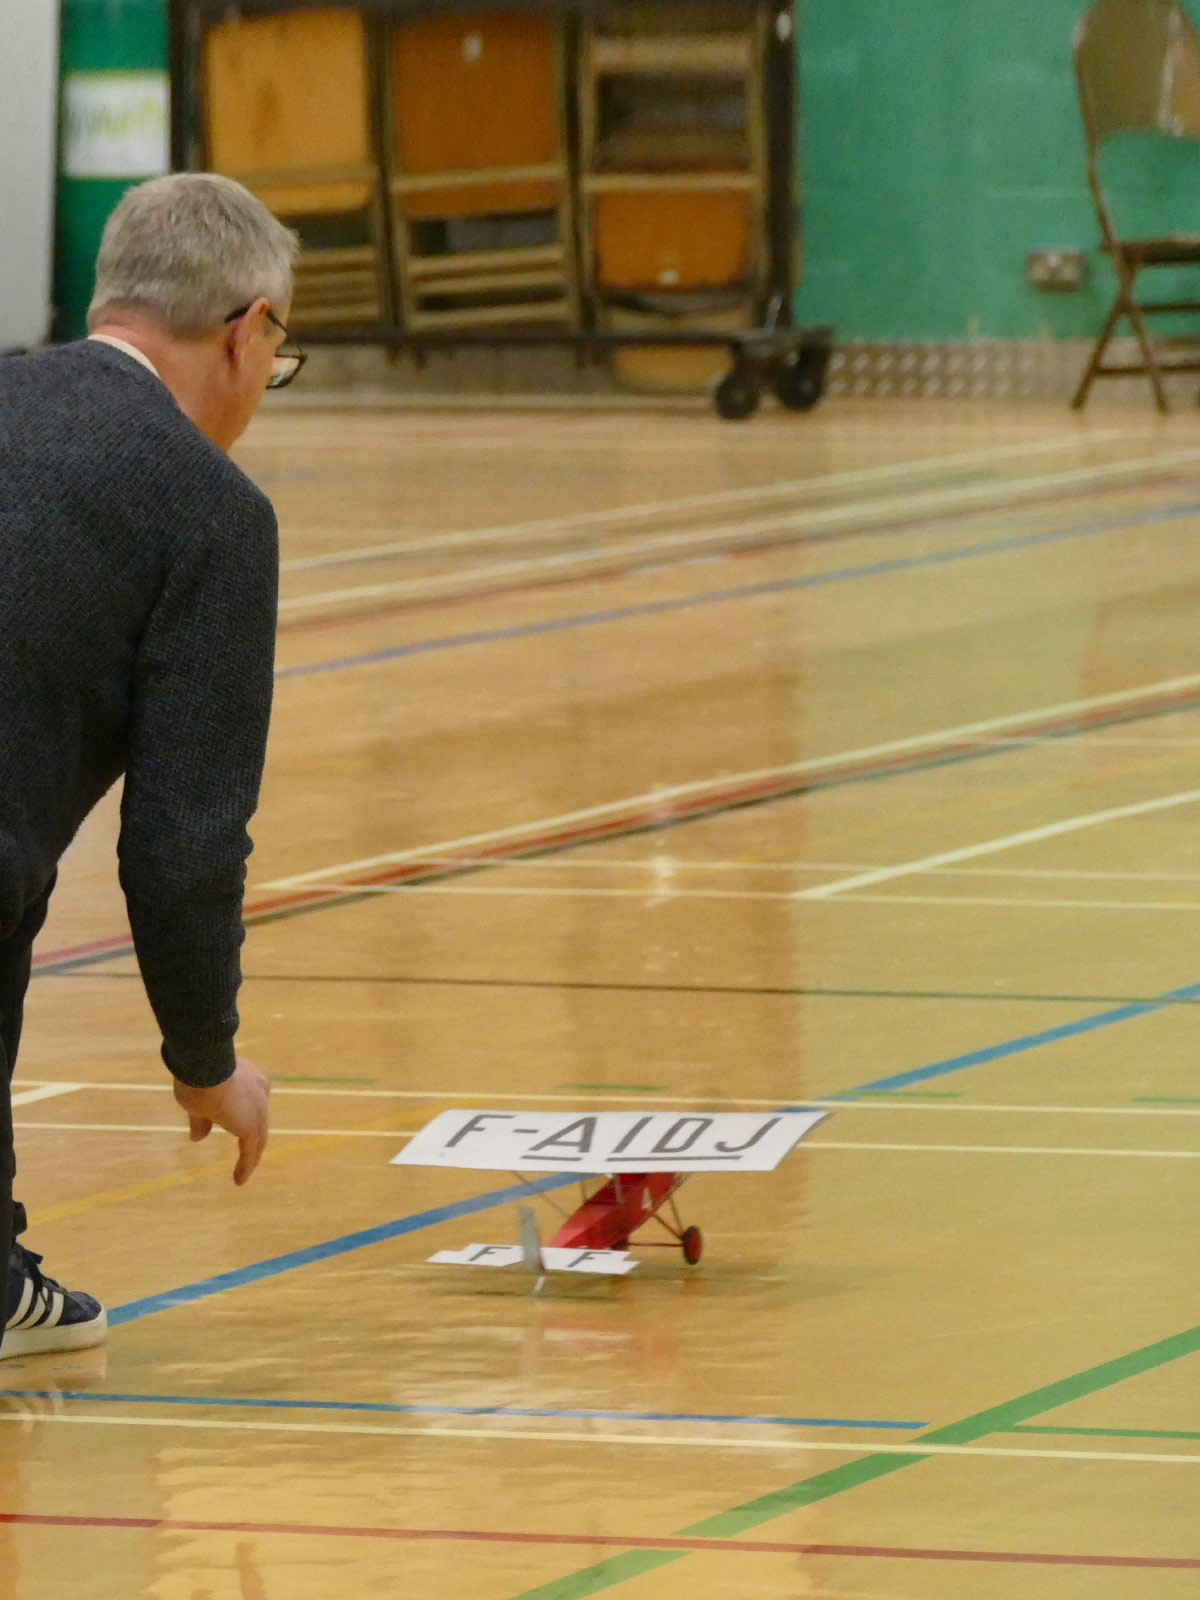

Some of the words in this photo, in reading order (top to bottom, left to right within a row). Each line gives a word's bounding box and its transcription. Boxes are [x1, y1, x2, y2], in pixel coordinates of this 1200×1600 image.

[445, 1113, 784, 1156] F-AIDJ
[468, 1245, 512, 1263] F
[566, 1251, 612, 1269] F
